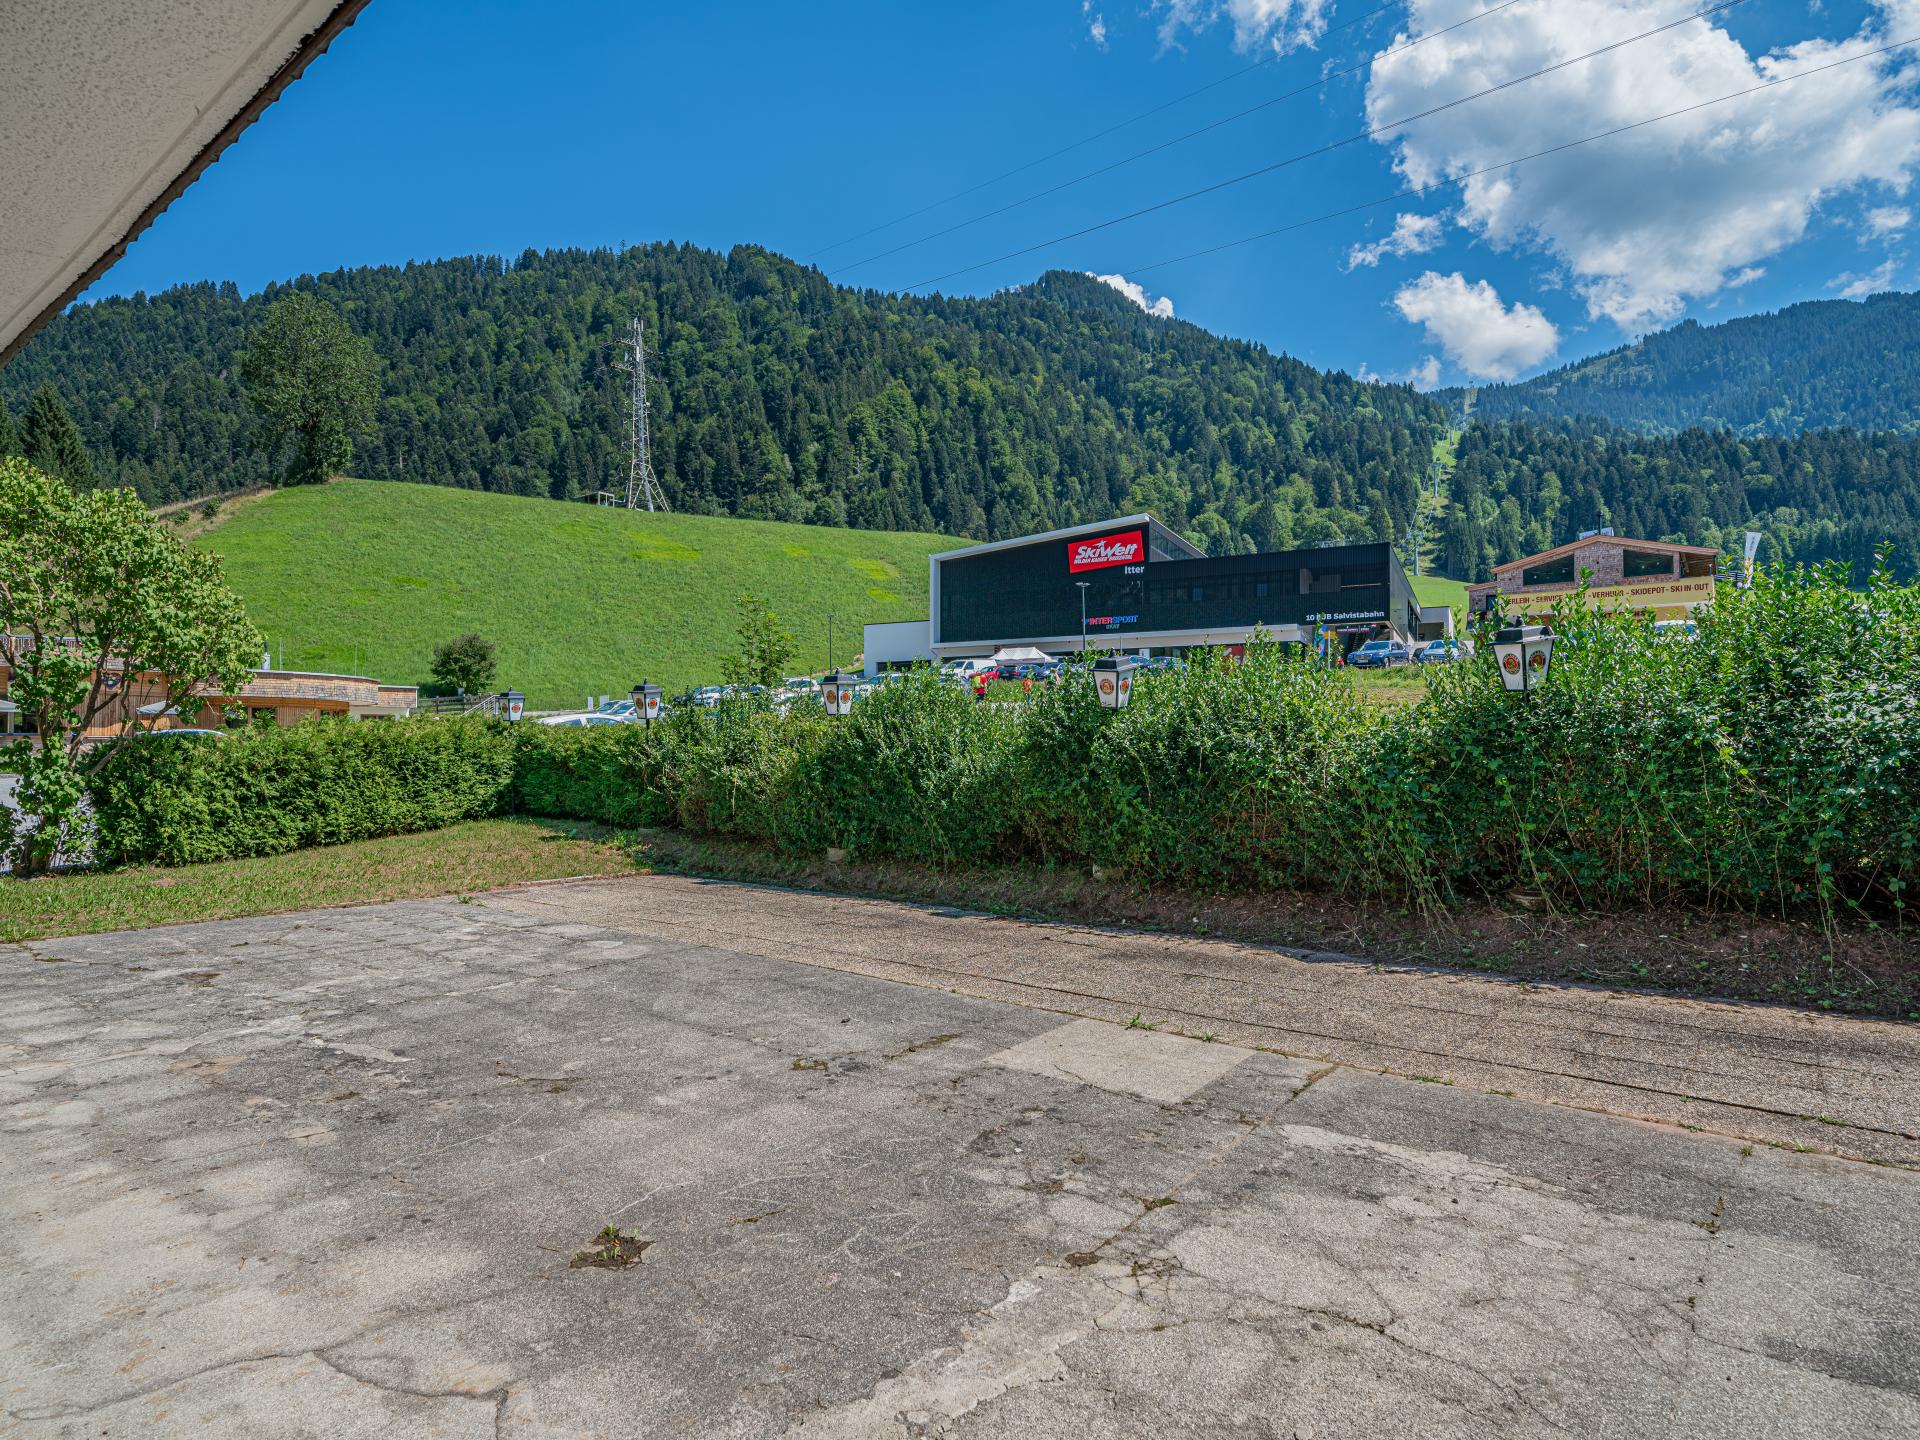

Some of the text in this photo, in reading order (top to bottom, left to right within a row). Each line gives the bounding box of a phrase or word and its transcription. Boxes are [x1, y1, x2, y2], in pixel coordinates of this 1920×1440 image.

[1075, 541, 1138, 559] SkiWelt
[1124, 565, 1145, 575] Itter
[1630, 586, 1665, 596] SKIDEPOT
[1670, 585, 1683, 593] SKI
[1089, 615, 1138, 625] INTERSPORT
[1333, 610, 1385, 620] Salvistabahn
